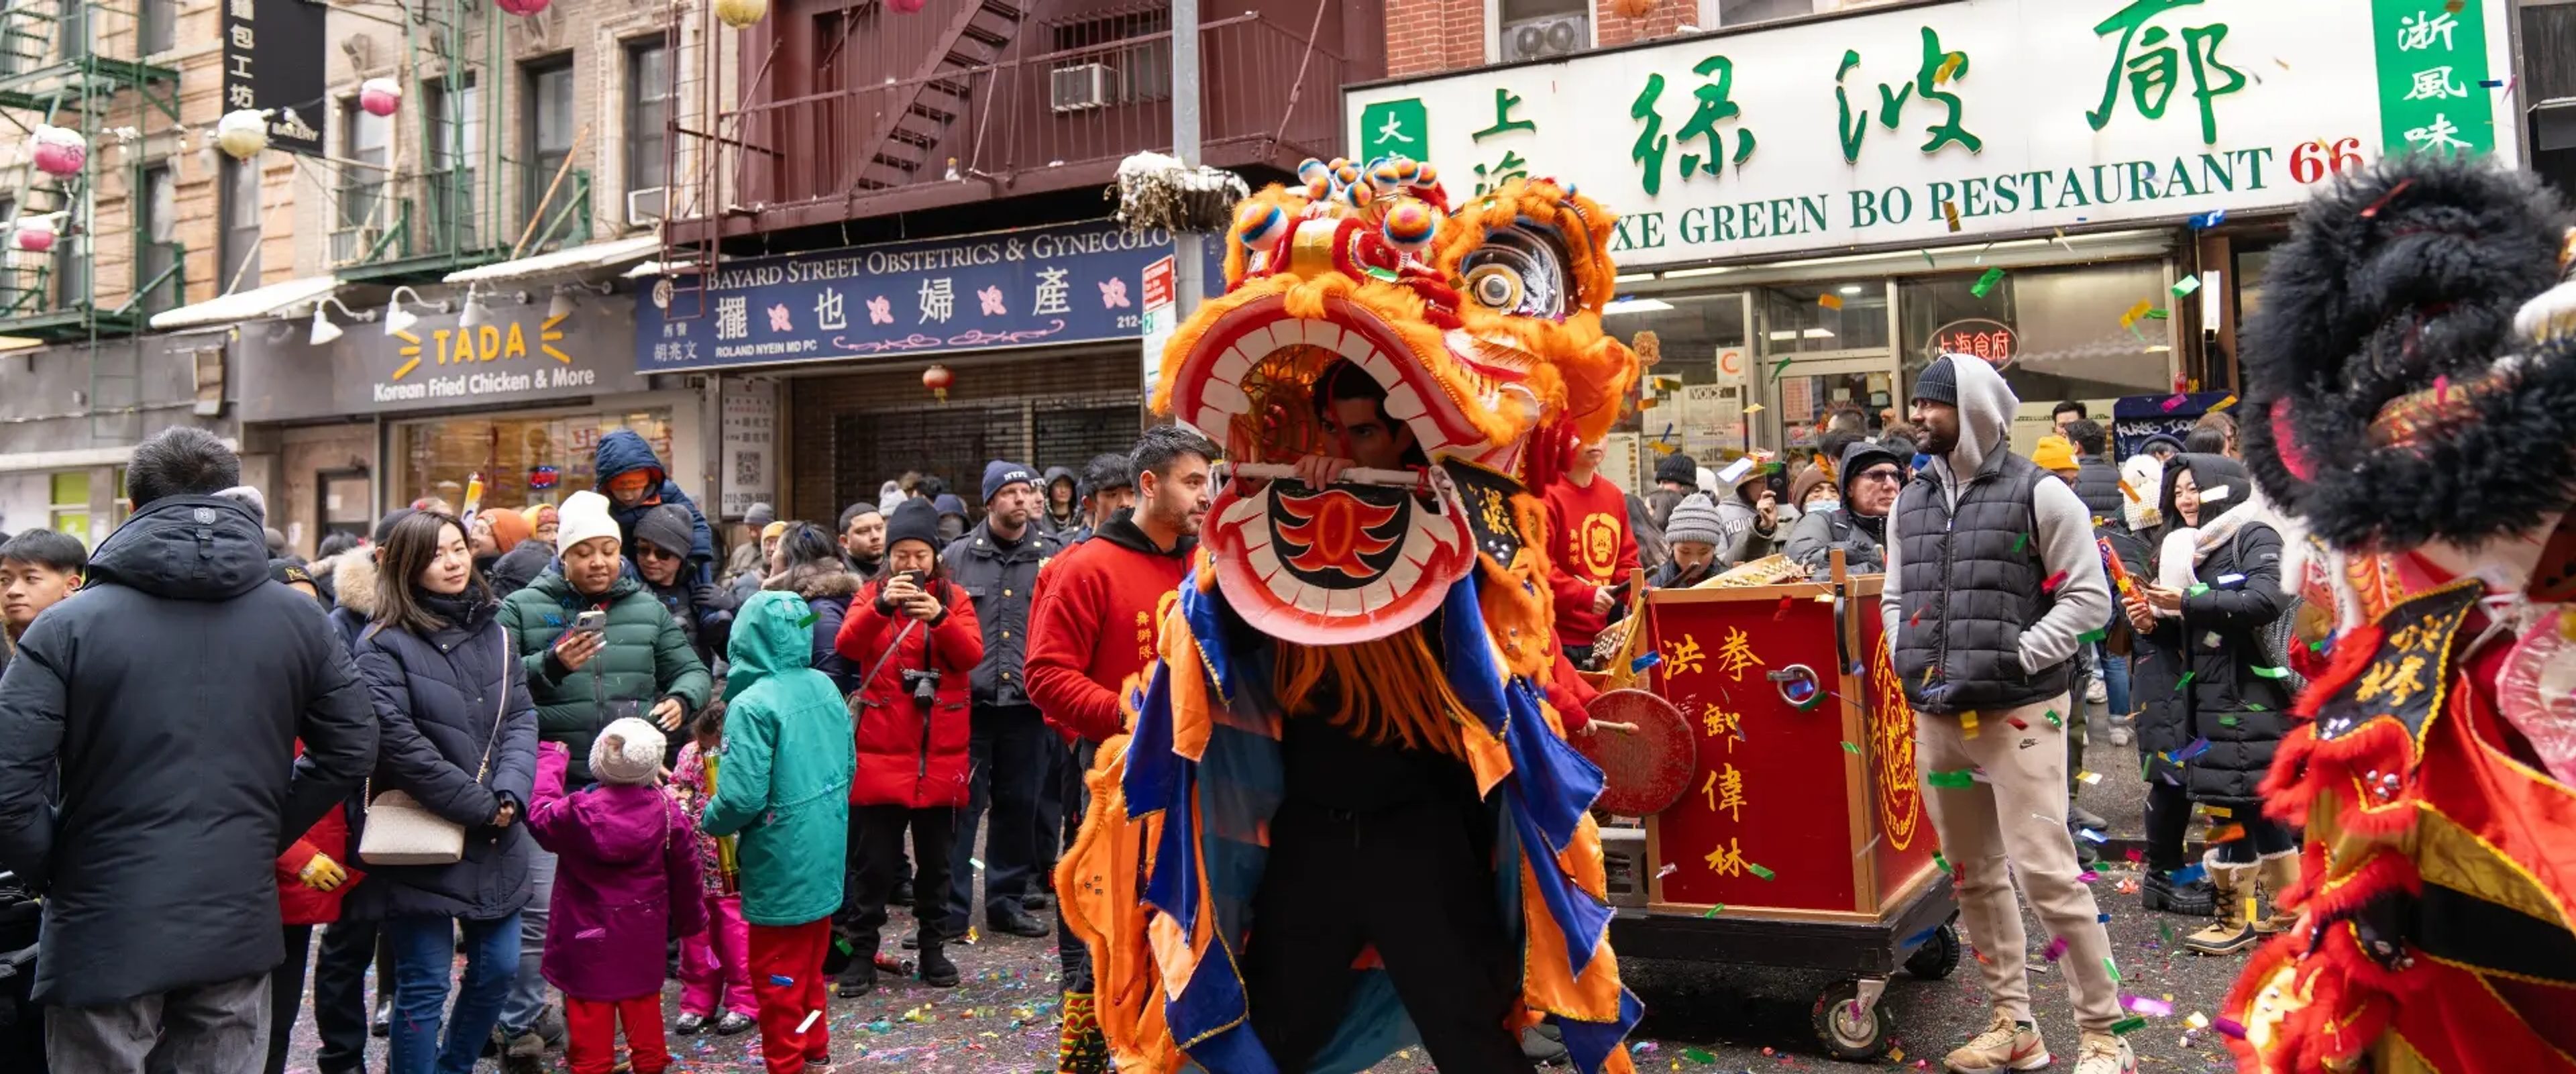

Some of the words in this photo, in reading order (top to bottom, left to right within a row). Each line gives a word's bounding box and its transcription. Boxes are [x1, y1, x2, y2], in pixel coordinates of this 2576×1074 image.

[1680, 195, 1829, 244] GREEN
[1849, 186, 1912, 229] BO
[1928, 147, 2273, 221] RESTAURANT
[2289, 137, 2365, 184] 66
[706, 268, 783, 291] BAYARD
[787, 256, 862, 283] STREET
[867, 244, 1000, 275] OBSTETRICS
[1006, 237, 1026, 262] &
[433, 322, 527, 366] TADA
[715, 345, 755, 359] ROLAND
[755, 342, 784, 356] NYEIN
[786, 341, 802, 354] MD
[803, 339, 818, 352] PC
[374, 381, 425, 402] Korean
[428, 377, 466, 398] Fried
[469, 372, 530, 394] Chicken
[535, 371, 548, 389] &
[552, 368, 595, 386] More
